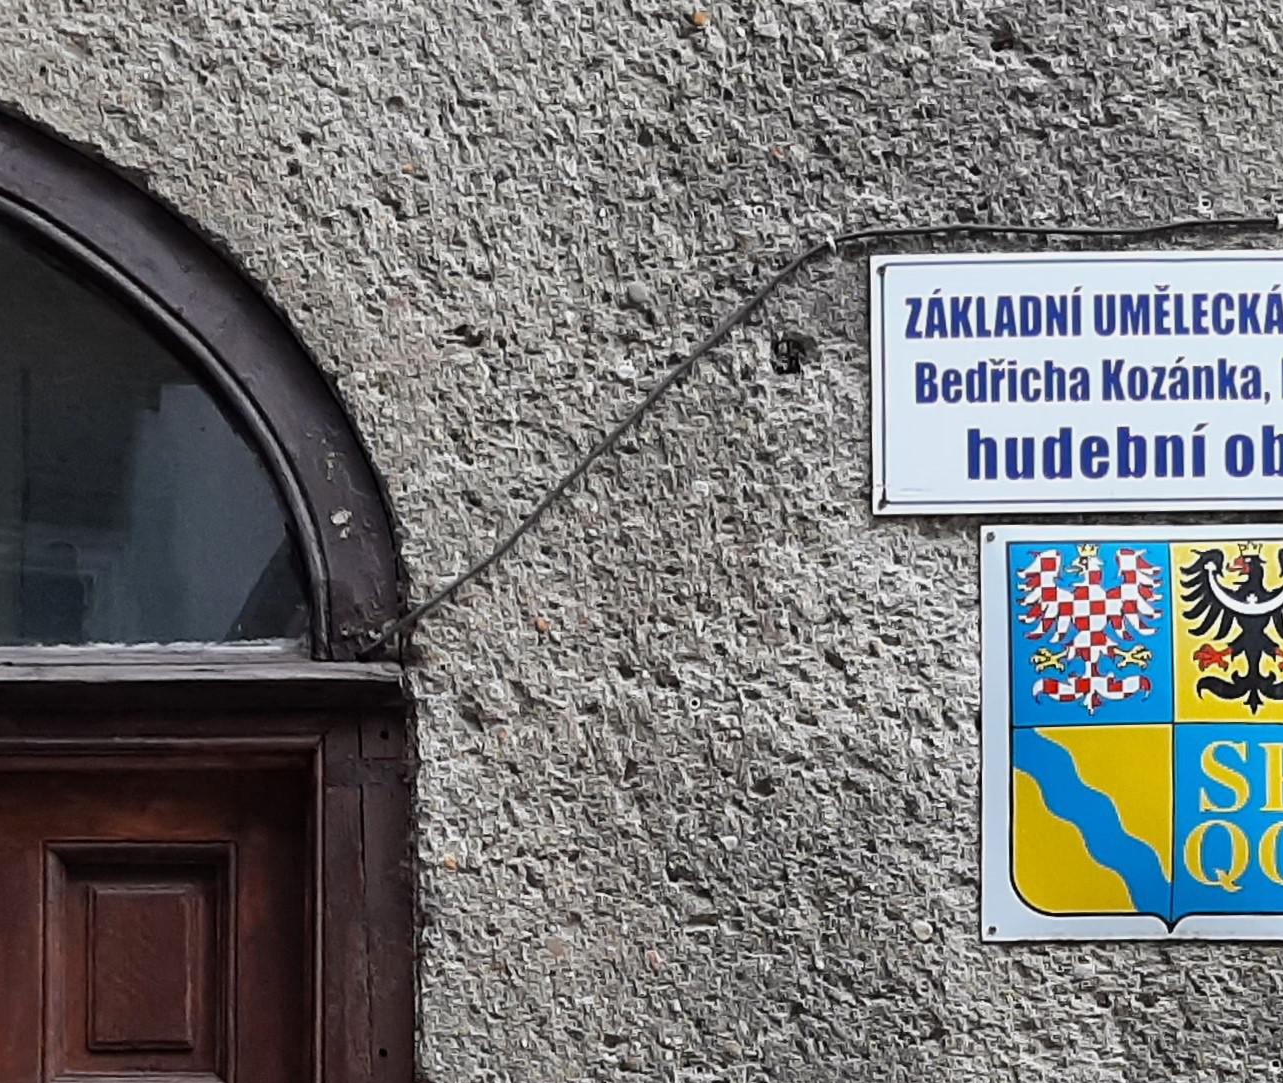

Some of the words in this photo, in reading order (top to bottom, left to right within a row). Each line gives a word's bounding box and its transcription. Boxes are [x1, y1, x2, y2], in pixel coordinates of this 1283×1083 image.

[905, 286, 1082, 339] ZÁKLADNÍ
[915, 358, 1091, 404] Bedřicha
[1101, 356, 1272, 405] Kozánka,
[966, 423, 1209, 480] hudební
